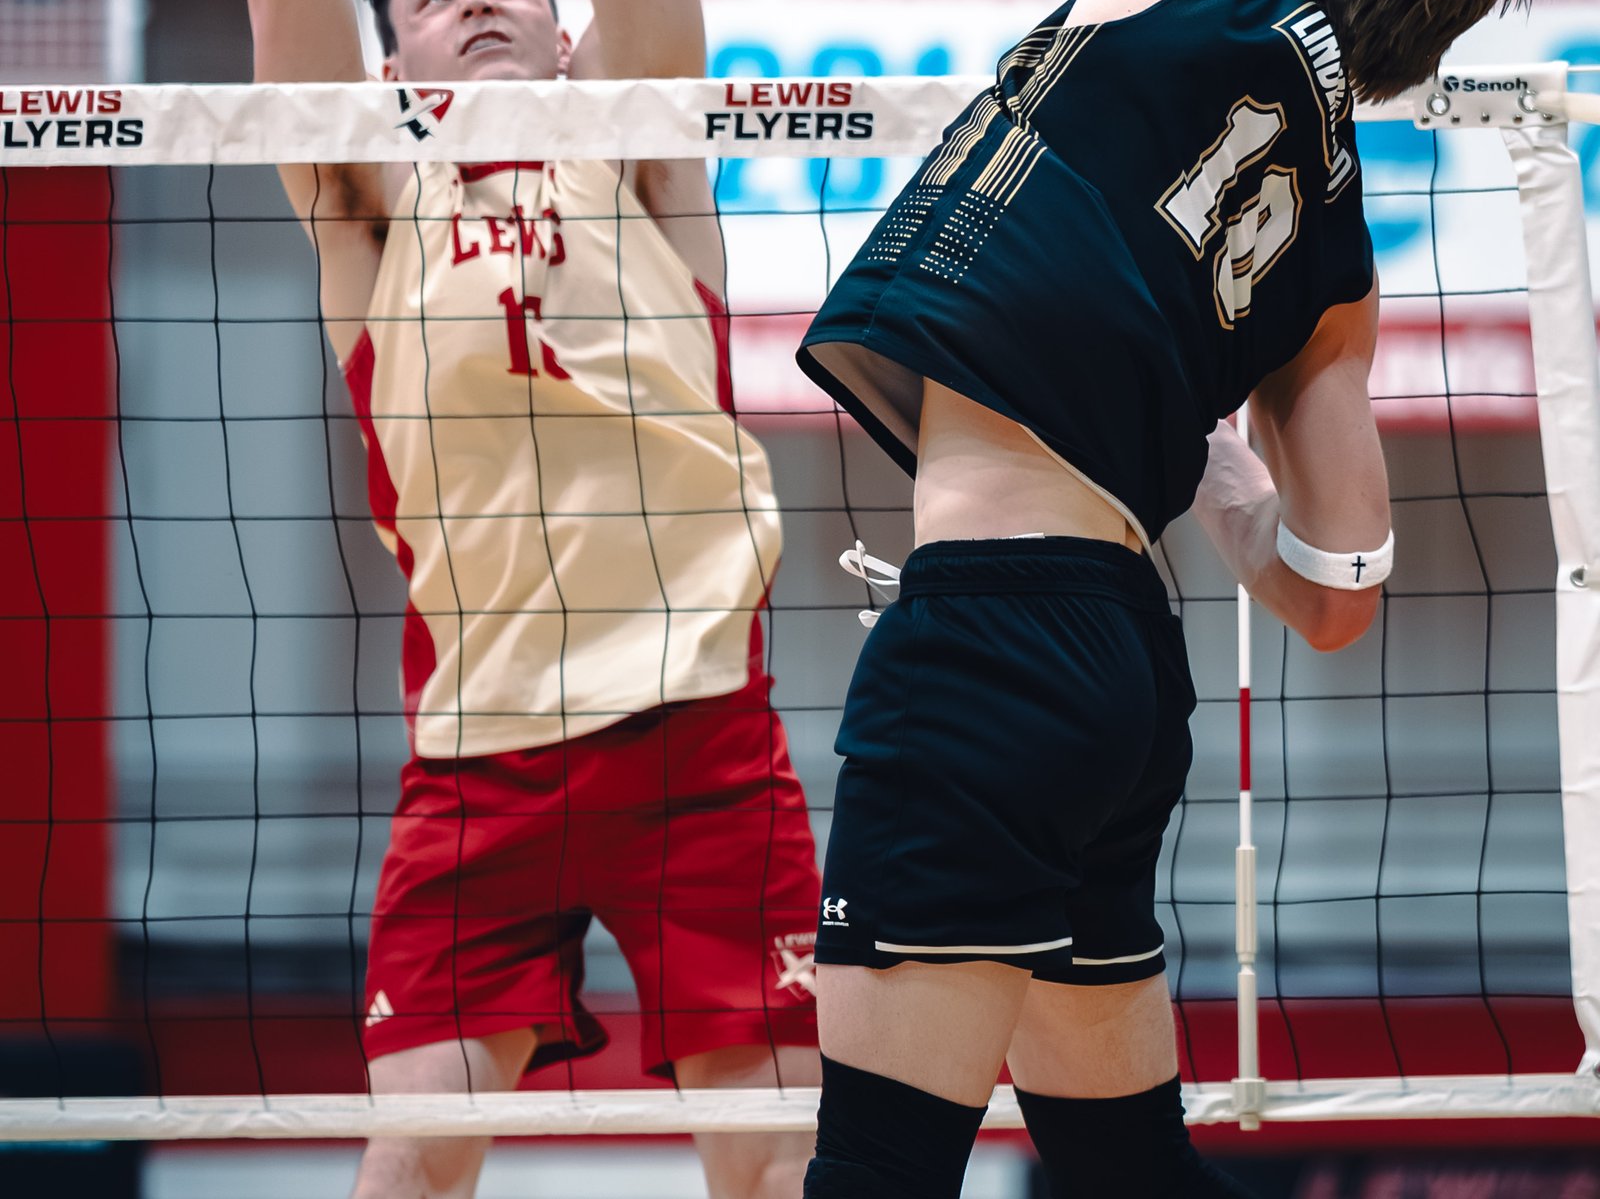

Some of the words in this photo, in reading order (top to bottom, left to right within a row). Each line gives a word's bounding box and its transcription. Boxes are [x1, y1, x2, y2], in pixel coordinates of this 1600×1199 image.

[725, 83, 852, 108] LEWIS
[1462, 77, 1527, 92] Senoh
[0, 89, 122, 115] LEWIS
[0, 119, 144, 148] LYERS
[705, 112, 873, 140] FLYERS
